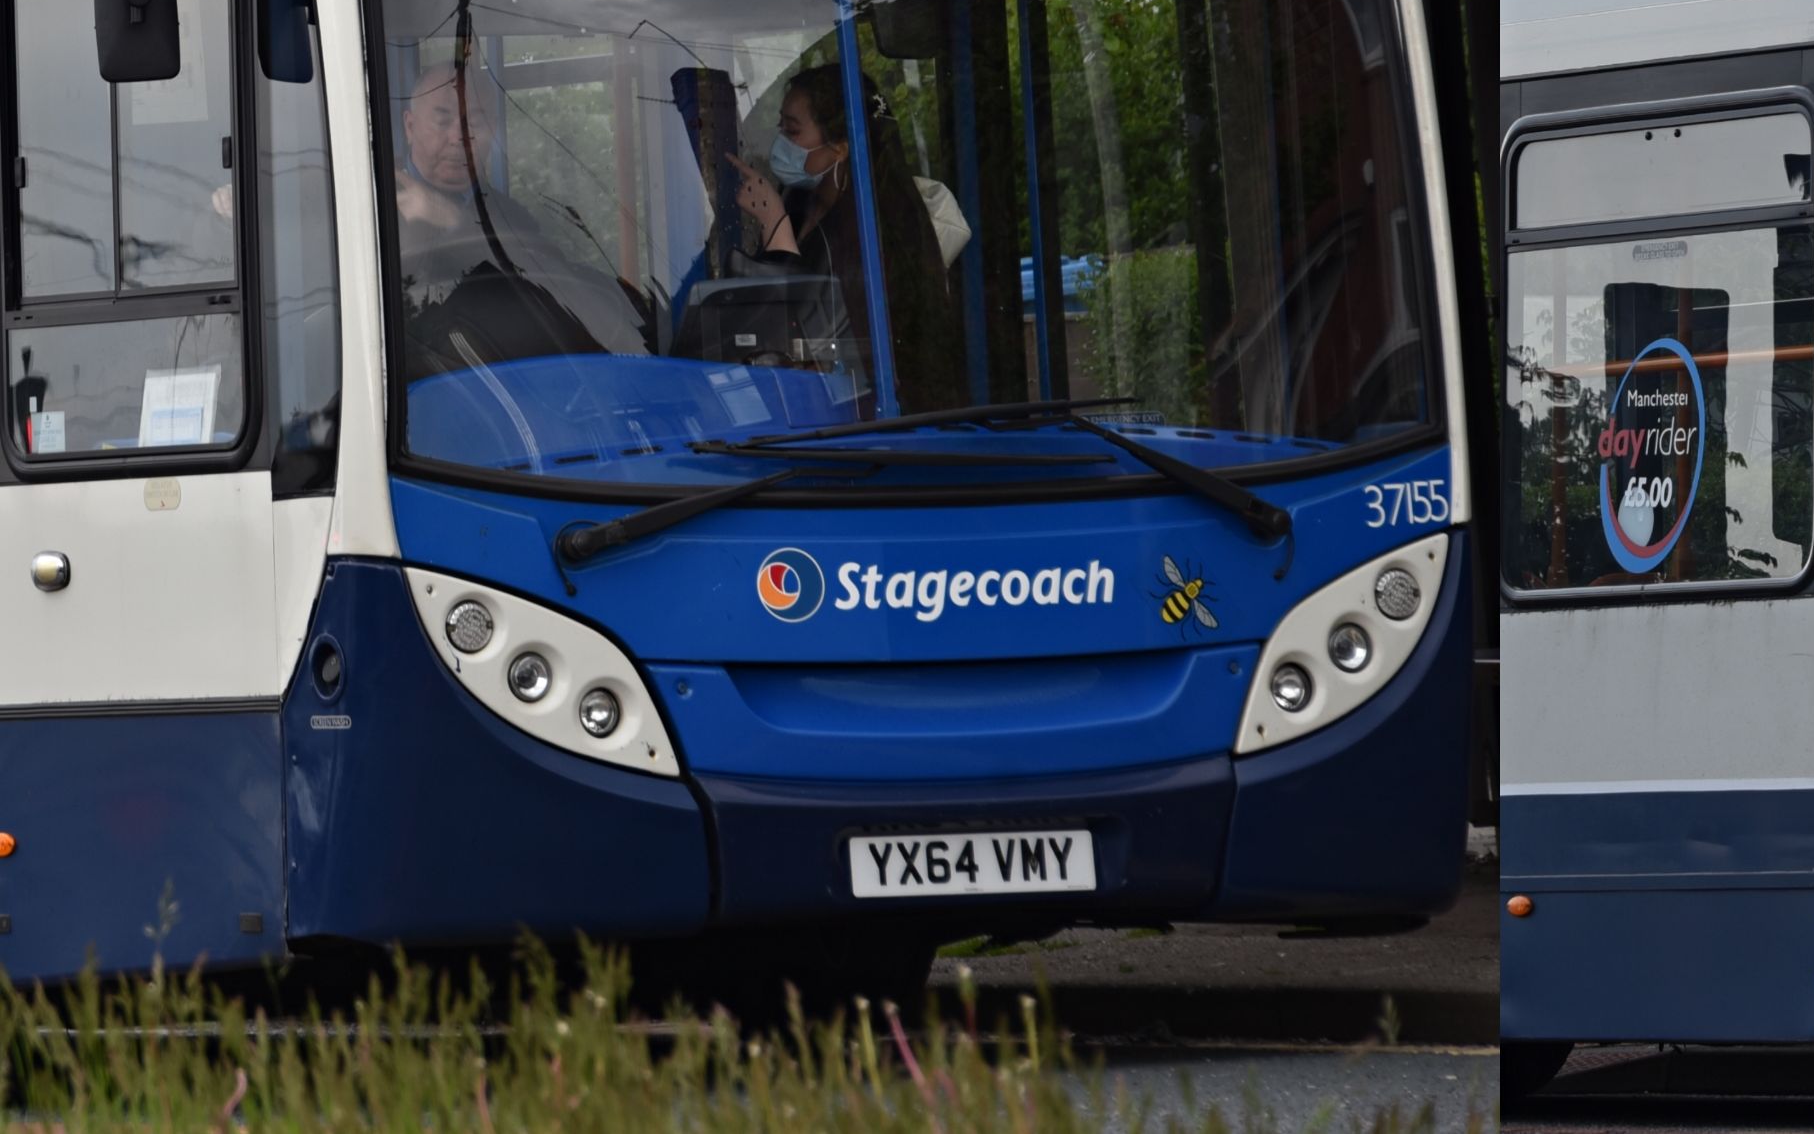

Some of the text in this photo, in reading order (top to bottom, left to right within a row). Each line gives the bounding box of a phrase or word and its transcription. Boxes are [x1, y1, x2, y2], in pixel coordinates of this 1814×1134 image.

[1364, 479, 1449, 528] 37155
[1624, 476, 1673, 508] £5.00
[834, 560, 1115, 622] Stagecoach
[868, 837, 1073, 886] YX64 VMY
